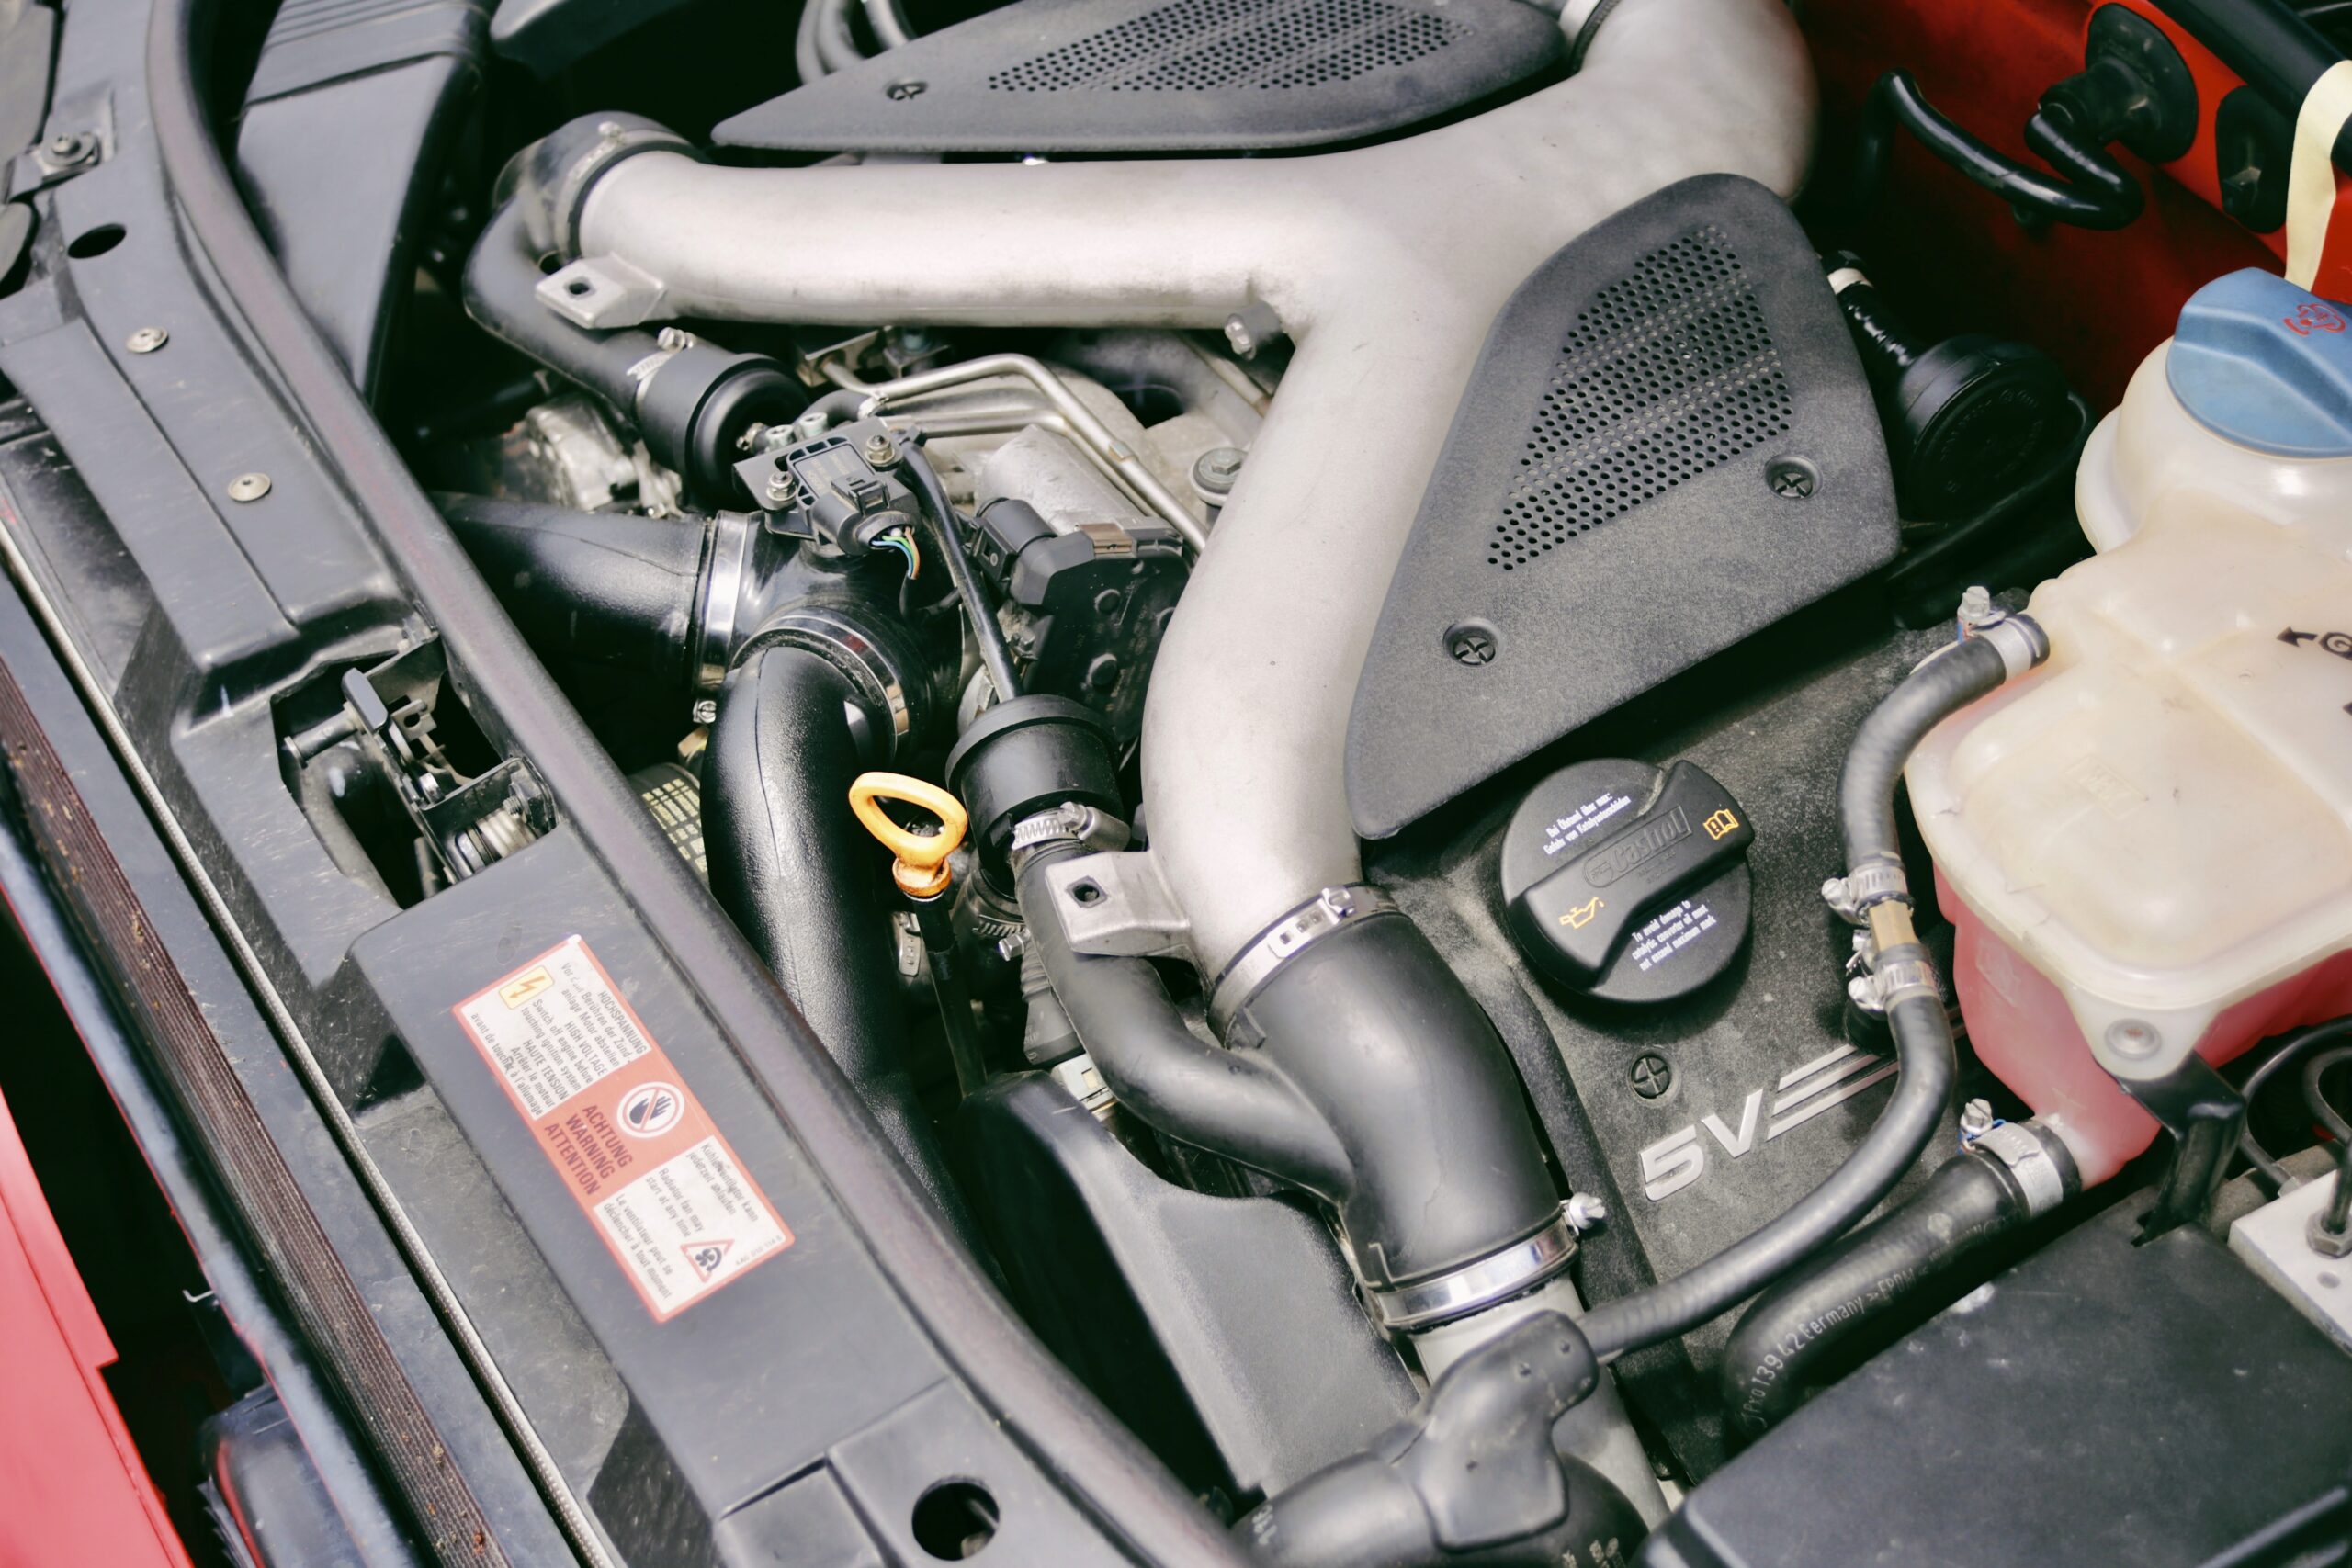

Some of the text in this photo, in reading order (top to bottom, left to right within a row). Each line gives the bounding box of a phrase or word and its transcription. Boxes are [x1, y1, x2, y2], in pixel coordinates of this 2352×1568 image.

[1612, 812, 1690, 874] Castrol
[470, 1013, 489, 1034] avant
[484, 1033, 495, 1043] de
[521, 1006, 581, 1091] touching ignition system
[532, 998, 593, 1083] Switch off engine before
[561, 989, 619, 1067] anlage Motor abstellen
[564, 1021, 607, 1076] HIGH VOLTAGE
[597, 990, 646, 1054] HOCHSPANNUNG
[604, 1026, 617, 1038] der
[510, 1046, 555, 1107] Arrêter le moteur
[522, 1039, 568, 1100] HAUTE TENSION
[544, 1123, 600, 1195] ATTENTION
[565, 1113, 614, 1178] WARNING
[581, 1105, 632, 1167] ACHTUNG
[645, 1176, 691, 1237] start at any time
[658, 1168, 703, 1231] Radiator fan may
[603, 1203, 633, 1242] déclencher
[635, 1249, 650, 1267] tout
[646, 1267, 671, 1298] moment
[615, 1193, 672, 1275] Le ventilateur peut se
[1800, 1293, 1866, 1345] Germany
